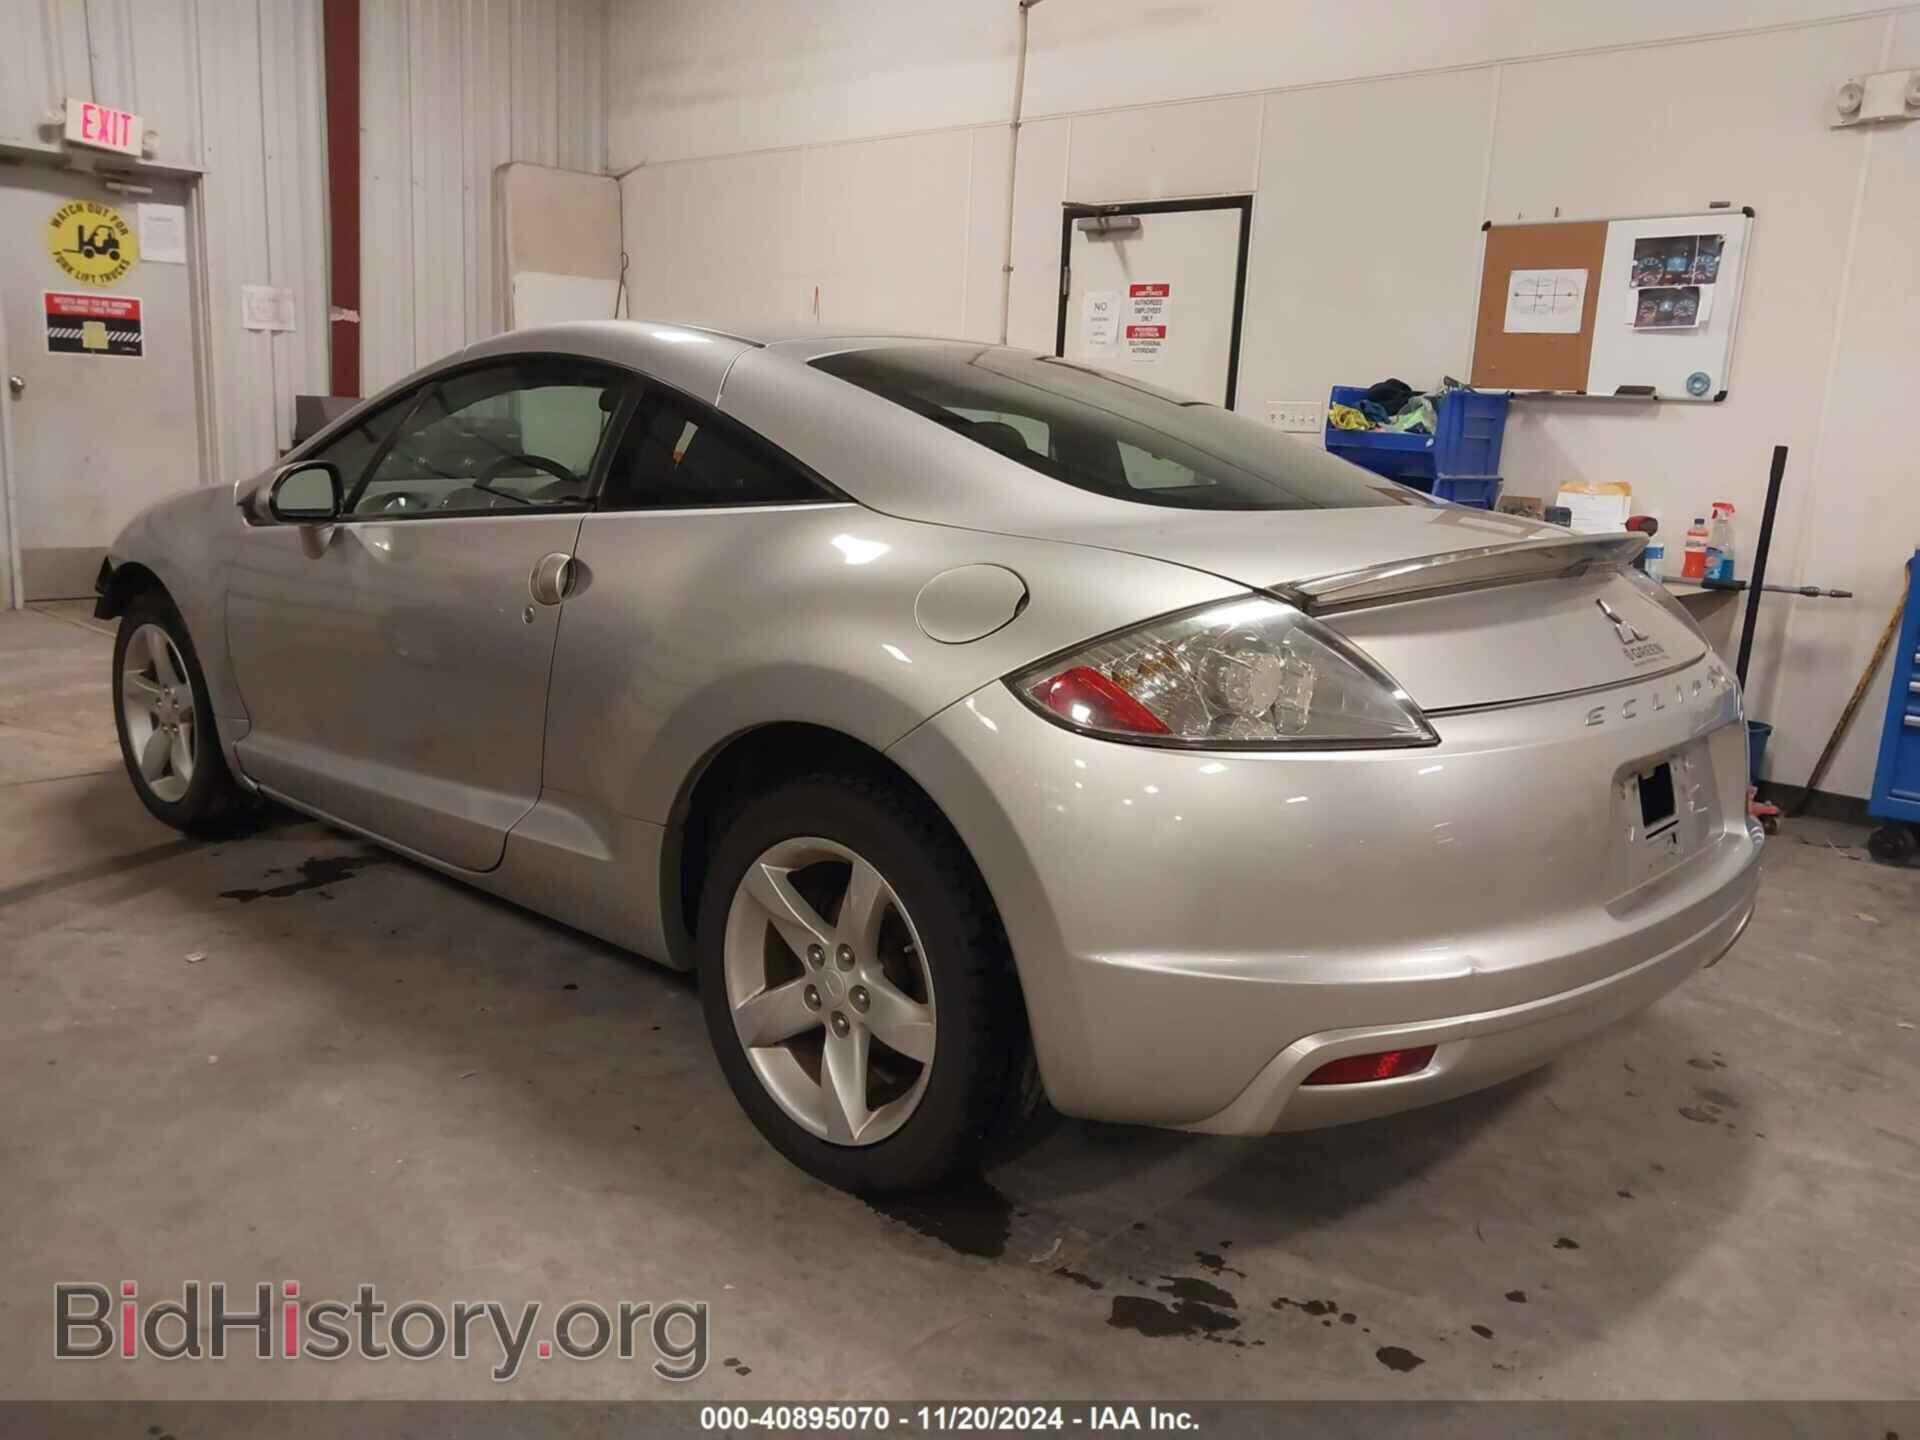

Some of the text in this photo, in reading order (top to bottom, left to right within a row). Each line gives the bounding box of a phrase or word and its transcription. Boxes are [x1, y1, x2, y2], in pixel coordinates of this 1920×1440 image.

[81, 103, 132, 147] EXIT
[51, 202, 84, 229] WATCH
[87, 202, 110, 218] OUT
[110, 215, 129, 236] FOR
[75, 271, 96, 284] LIFT
[99, 258, 131, 283] TRUCKS
[1094, 302, 1107, 312] NO
